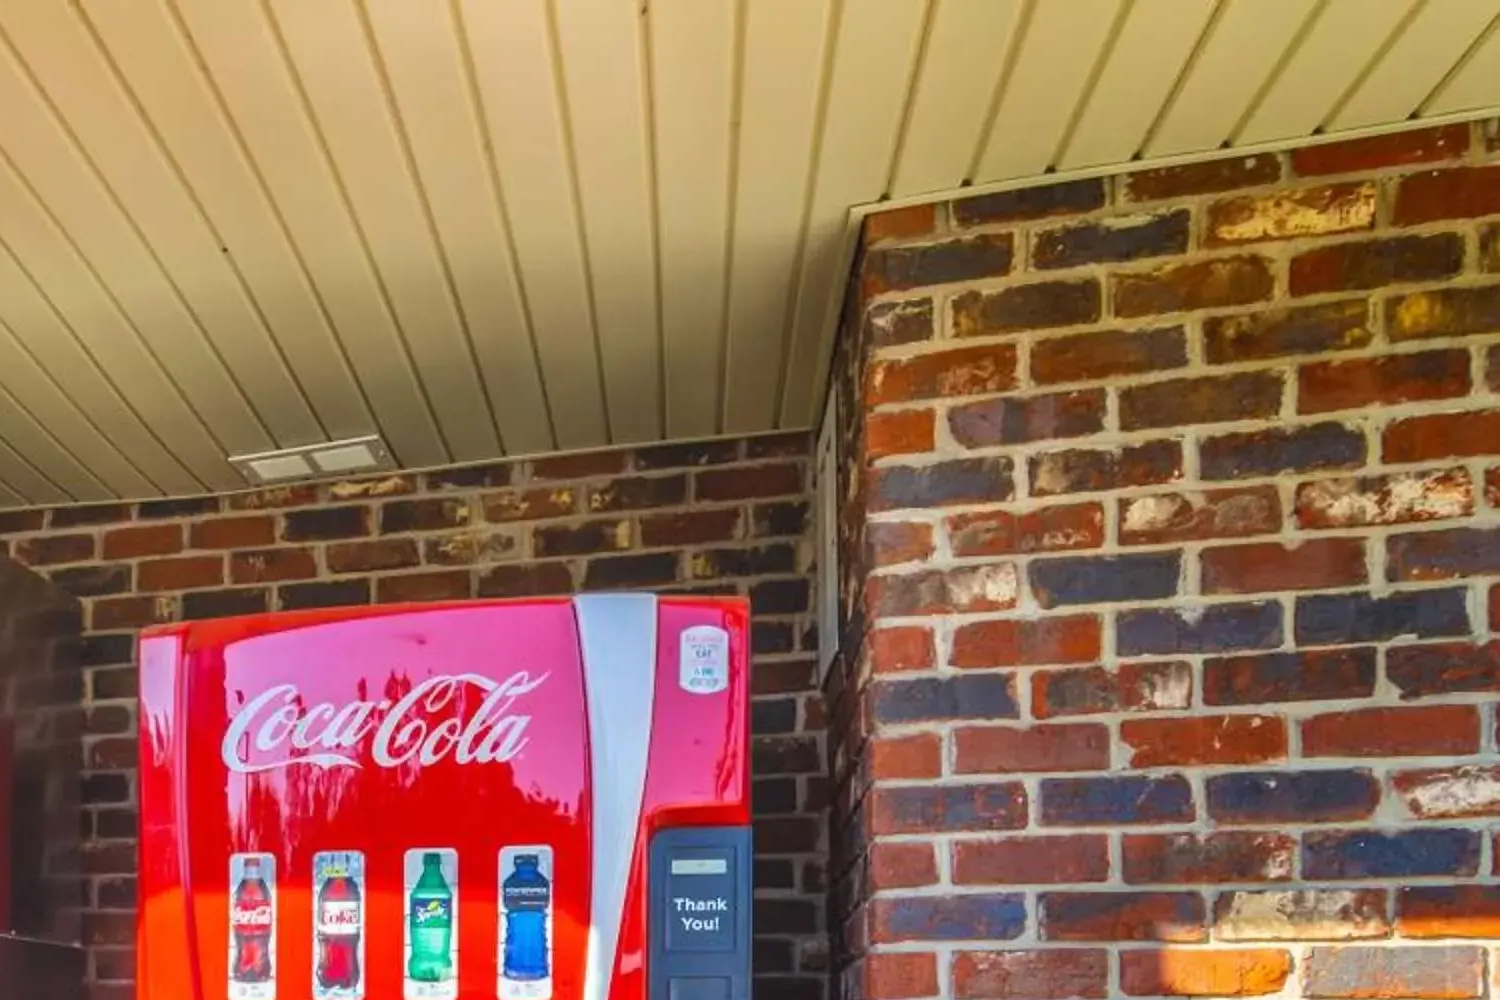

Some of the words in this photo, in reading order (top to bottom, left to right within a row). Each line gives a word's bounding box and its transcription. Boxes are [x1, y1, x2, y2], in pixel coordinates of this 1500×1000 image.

[222, 671, 551, 772] Coca-Cola
[673, 897, 728, 912] Thank
[681, 916, 719, 931] You!
